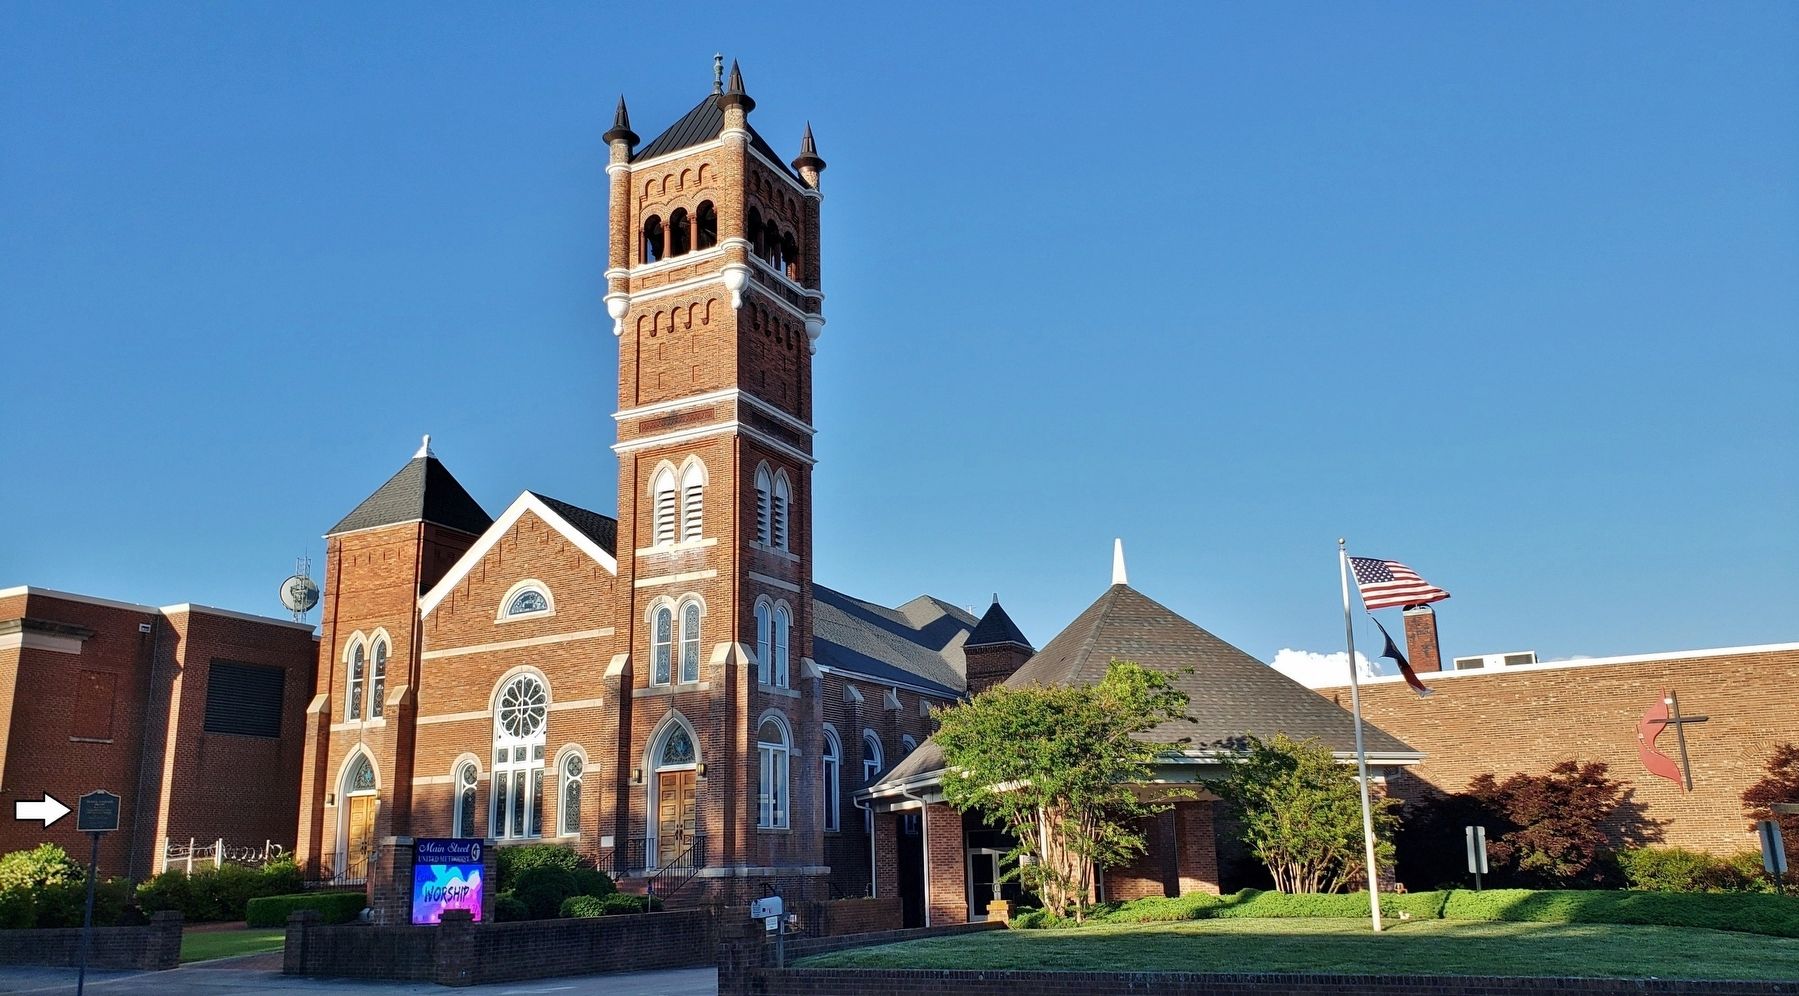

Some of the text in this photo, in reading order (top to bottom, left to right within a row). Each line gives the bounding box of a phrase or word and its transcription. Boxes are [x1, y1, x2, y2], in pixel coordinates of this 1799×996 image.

[419, 842, 470, 852] Main Street
[424, 885, 470, 904] WORSHIP
